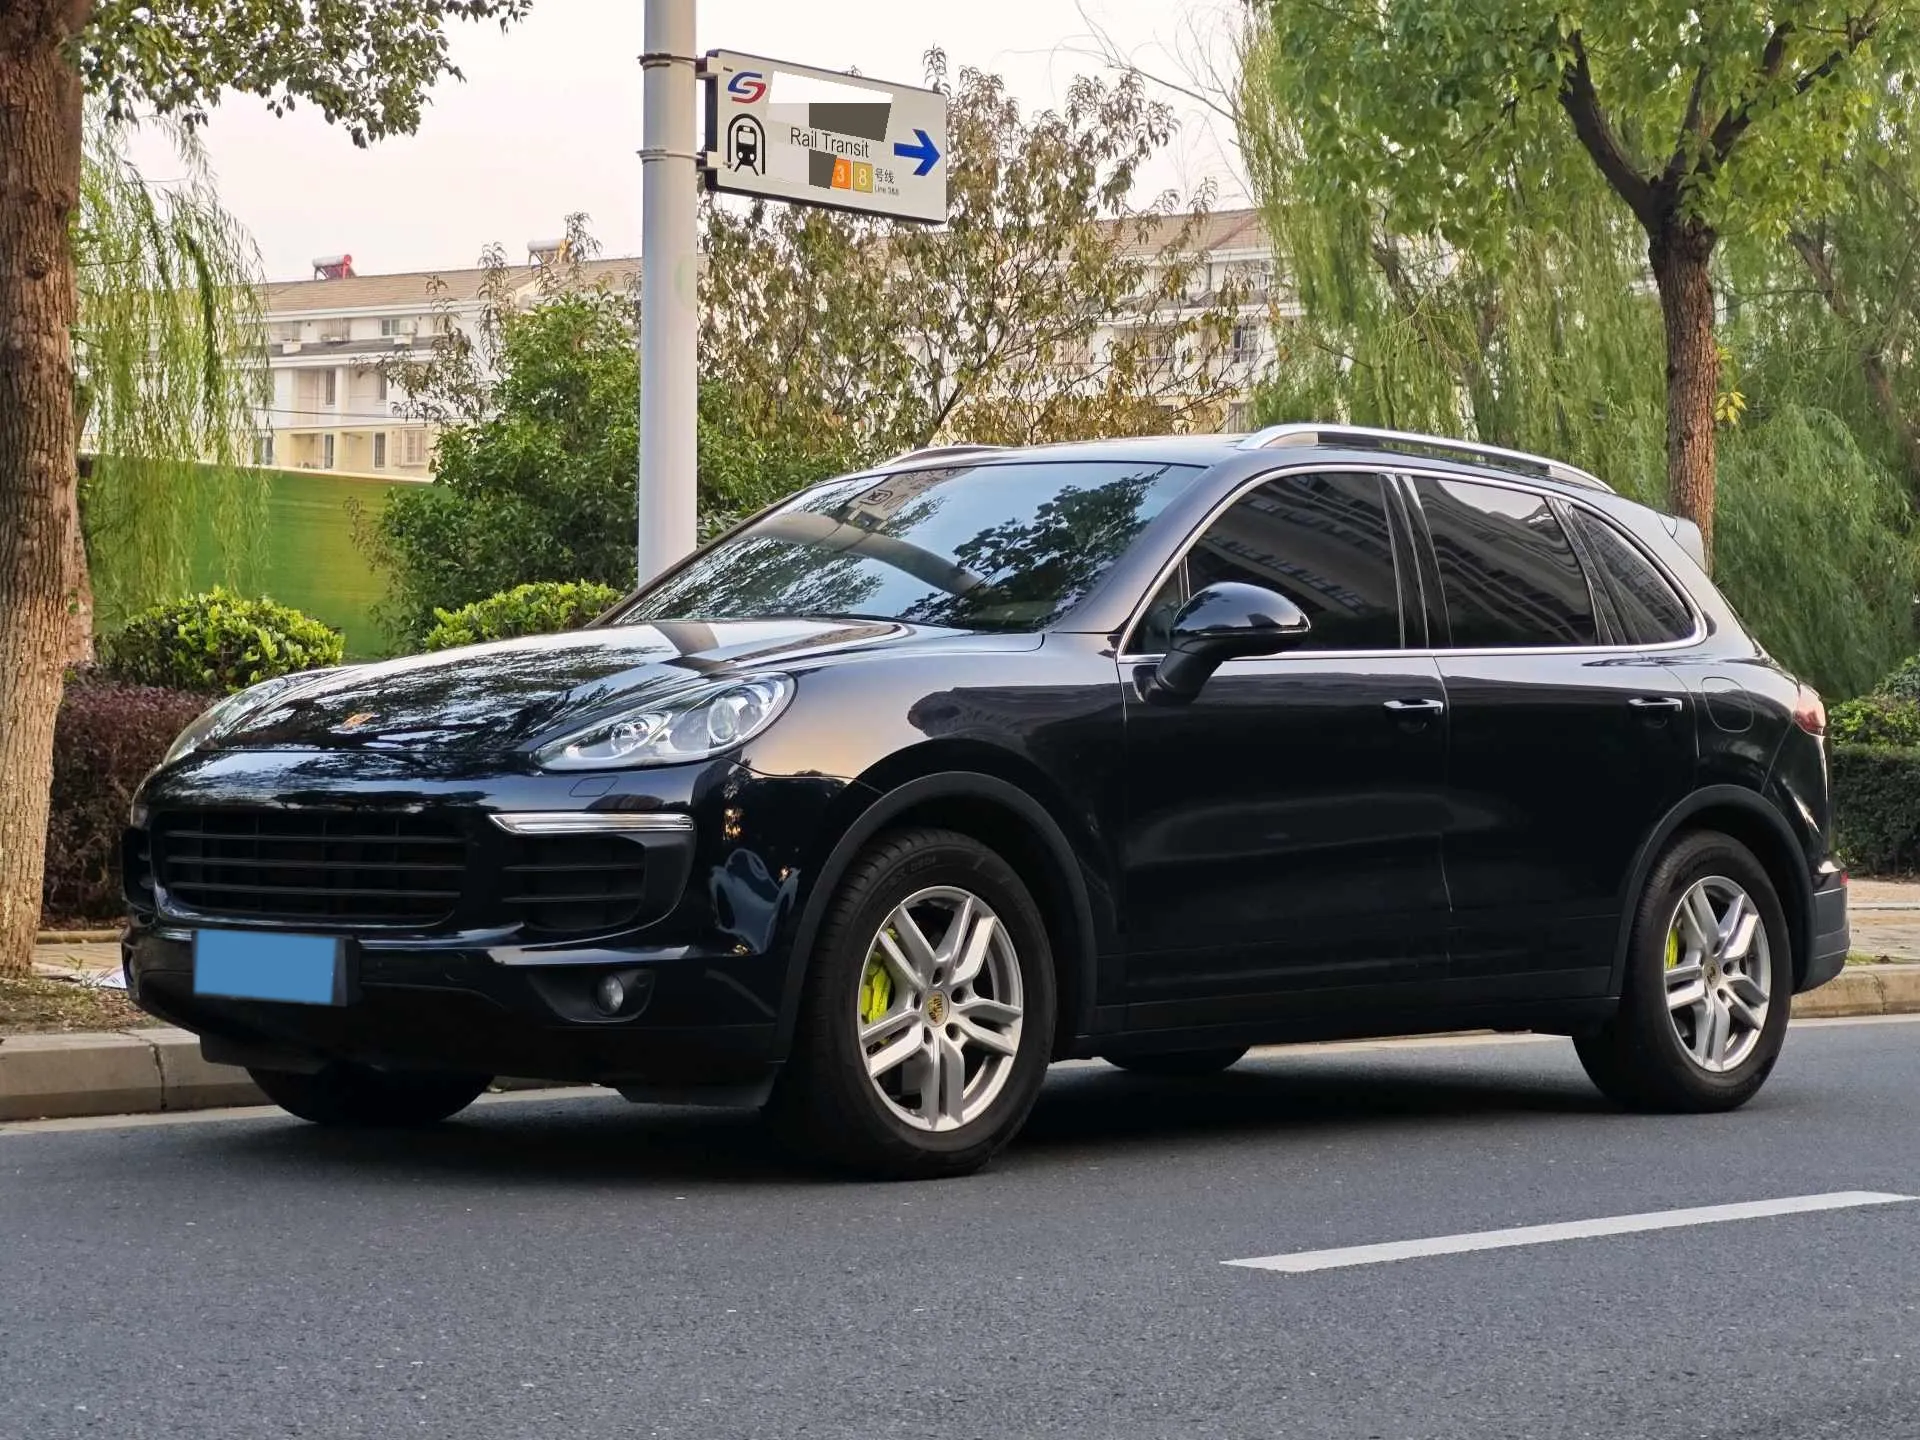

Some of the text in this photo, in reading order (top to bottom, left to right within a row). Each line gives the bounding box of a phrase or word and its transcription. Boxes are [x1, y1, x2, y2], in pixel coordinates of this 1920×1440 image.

[790, 127, 870, 158] Rail Transit
[836, 165, 895, 186] 3 8 号线
